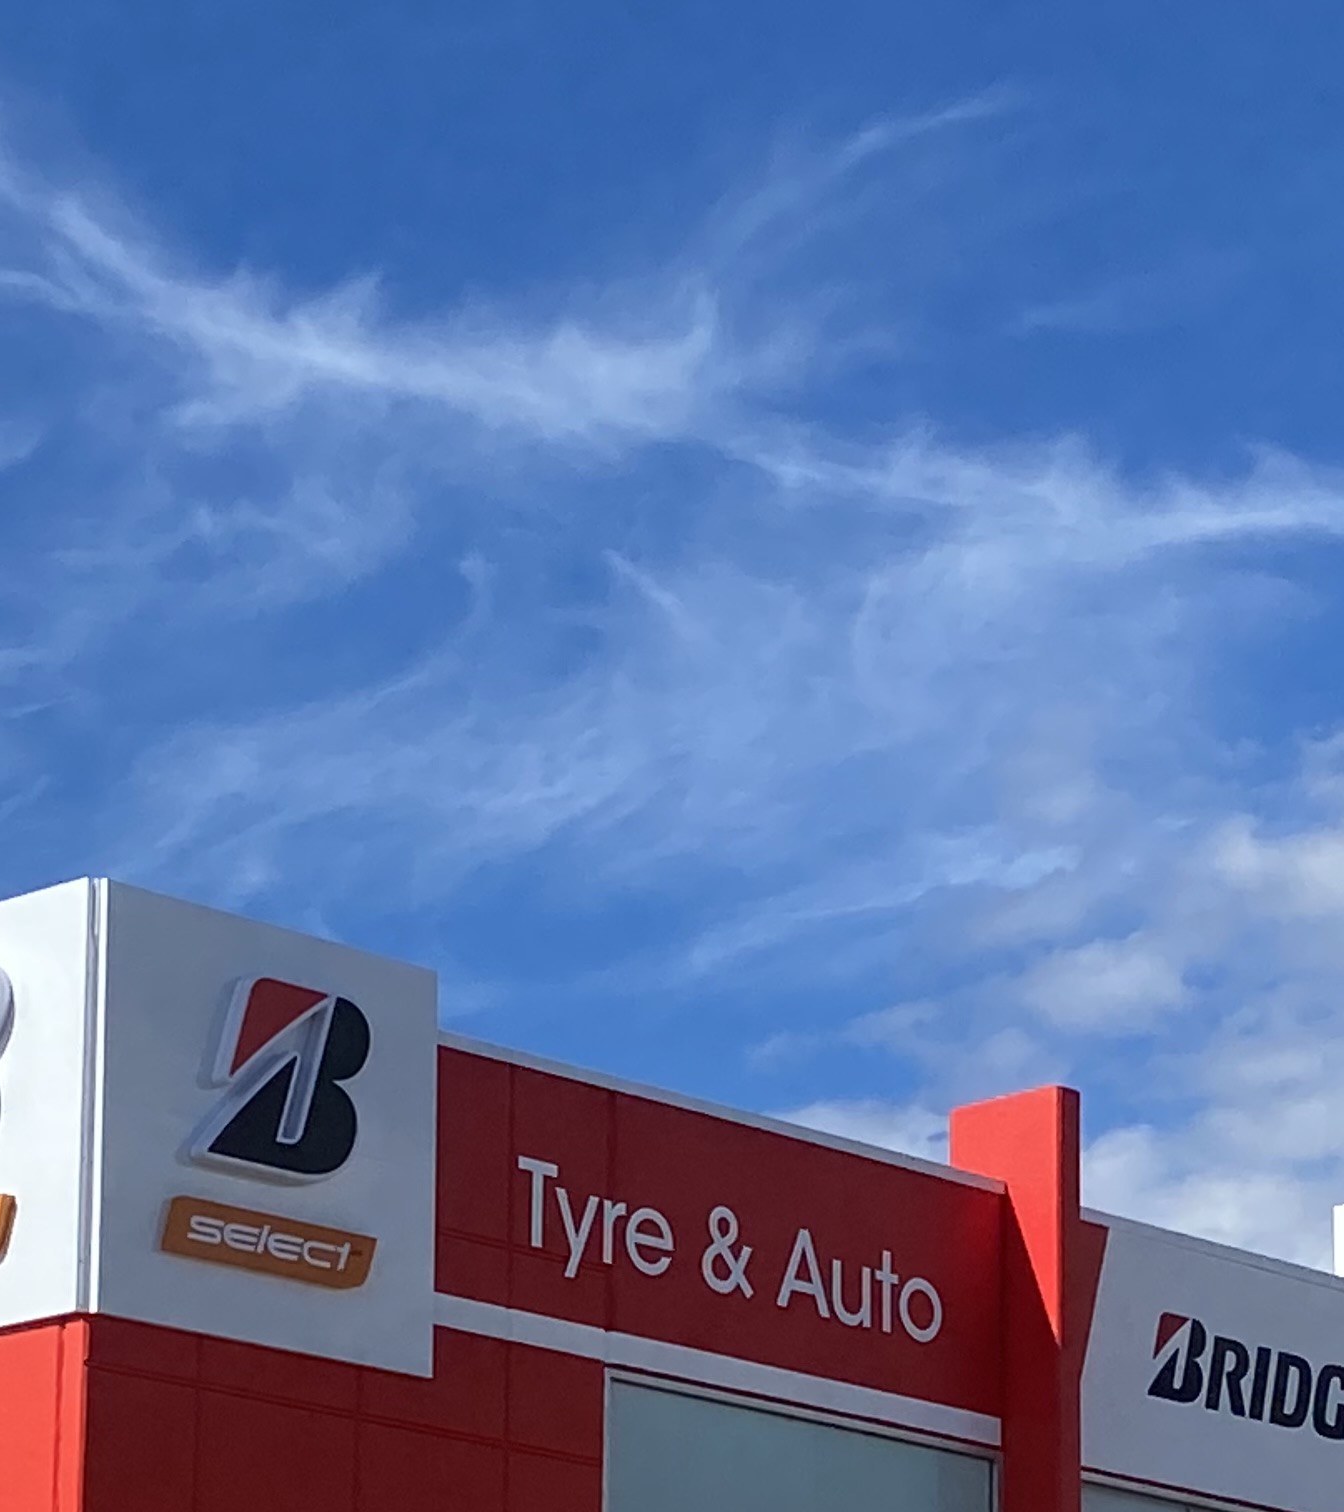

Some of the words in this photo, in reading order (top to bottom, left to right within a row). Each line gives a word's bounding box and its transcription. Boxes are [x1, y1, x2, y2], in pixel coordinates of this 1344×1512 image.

[186, 1212, 364, 1272] select
[517, 1155, 675, 1279] Tyre
[701, 1205, 754, 1300] &
[776, 1227, 943, 1343] Auto
